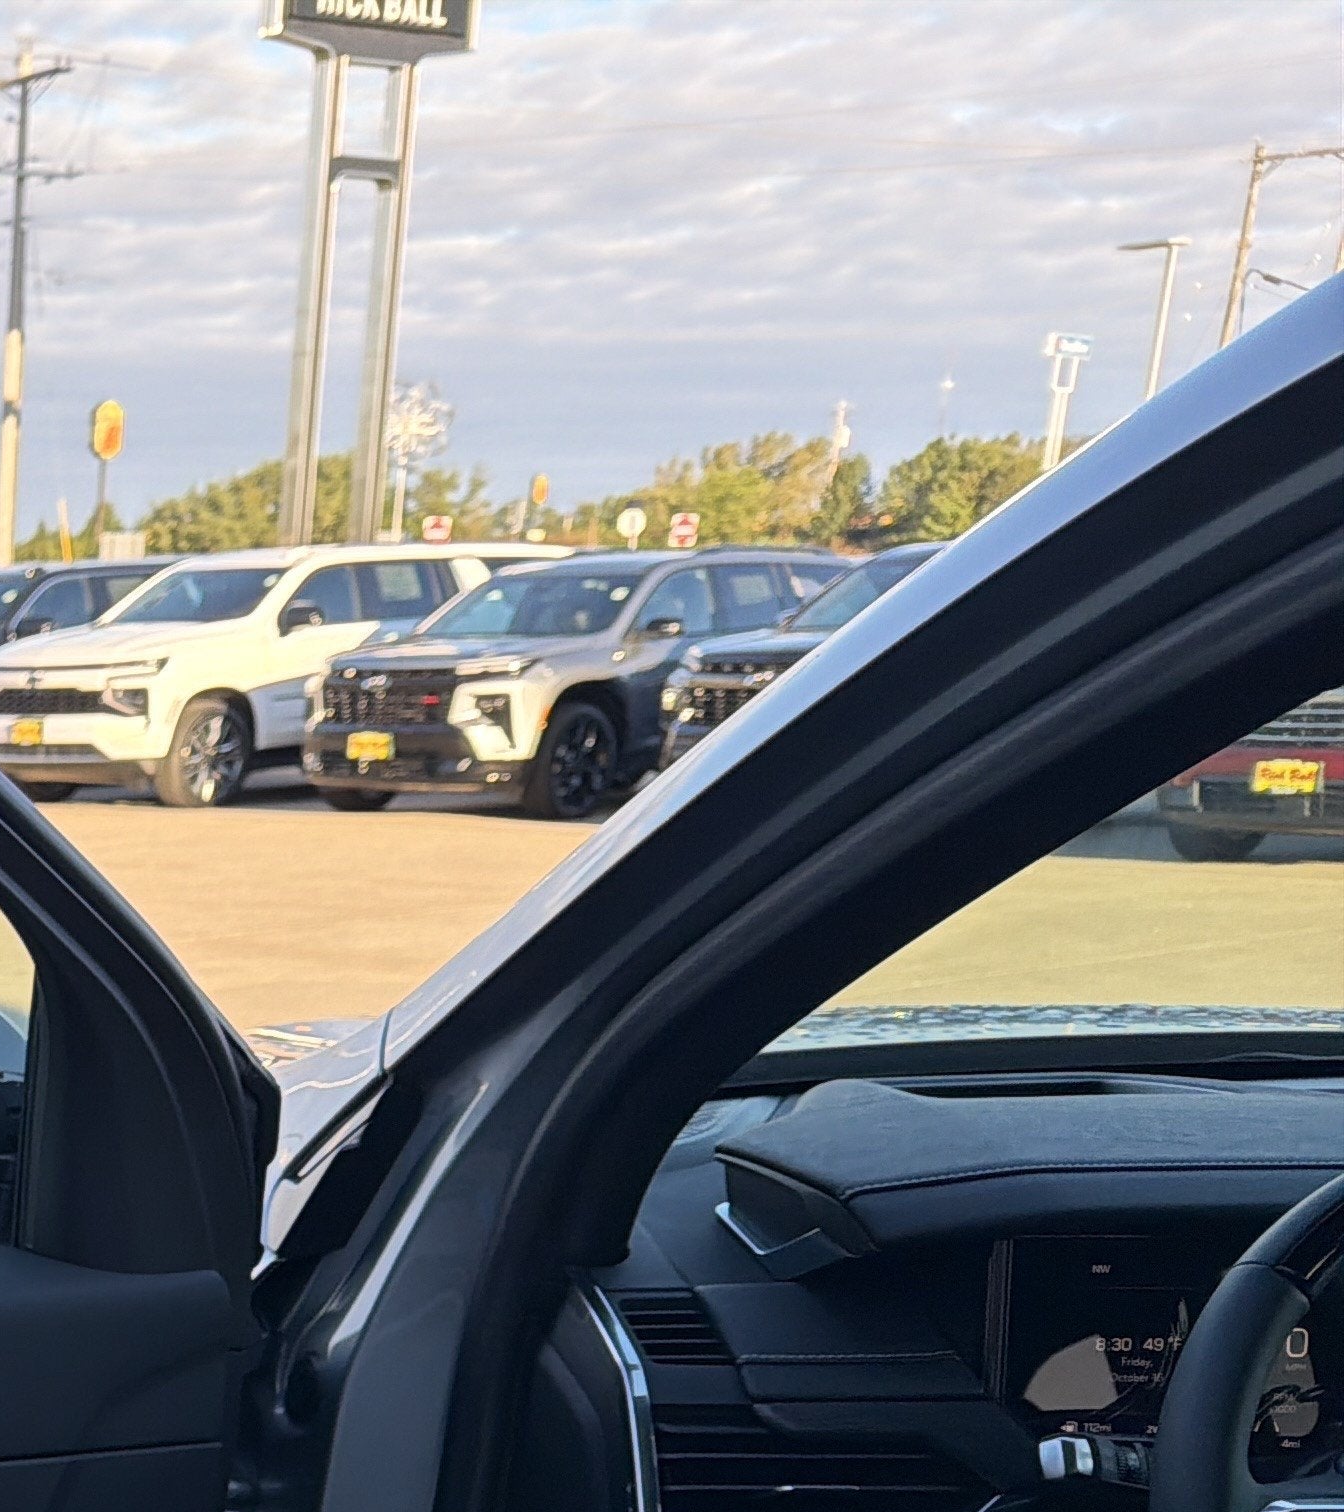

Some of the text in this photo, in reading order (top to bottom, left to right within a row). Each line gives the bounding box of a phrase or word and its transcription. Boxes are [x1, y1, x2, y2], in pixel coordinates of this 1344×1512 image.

[1091, 1264, 1111, 1274] NW
[1095, 1337, 1133, 1352] 8:30
[1286, 1327, 1309, 1358] 0
